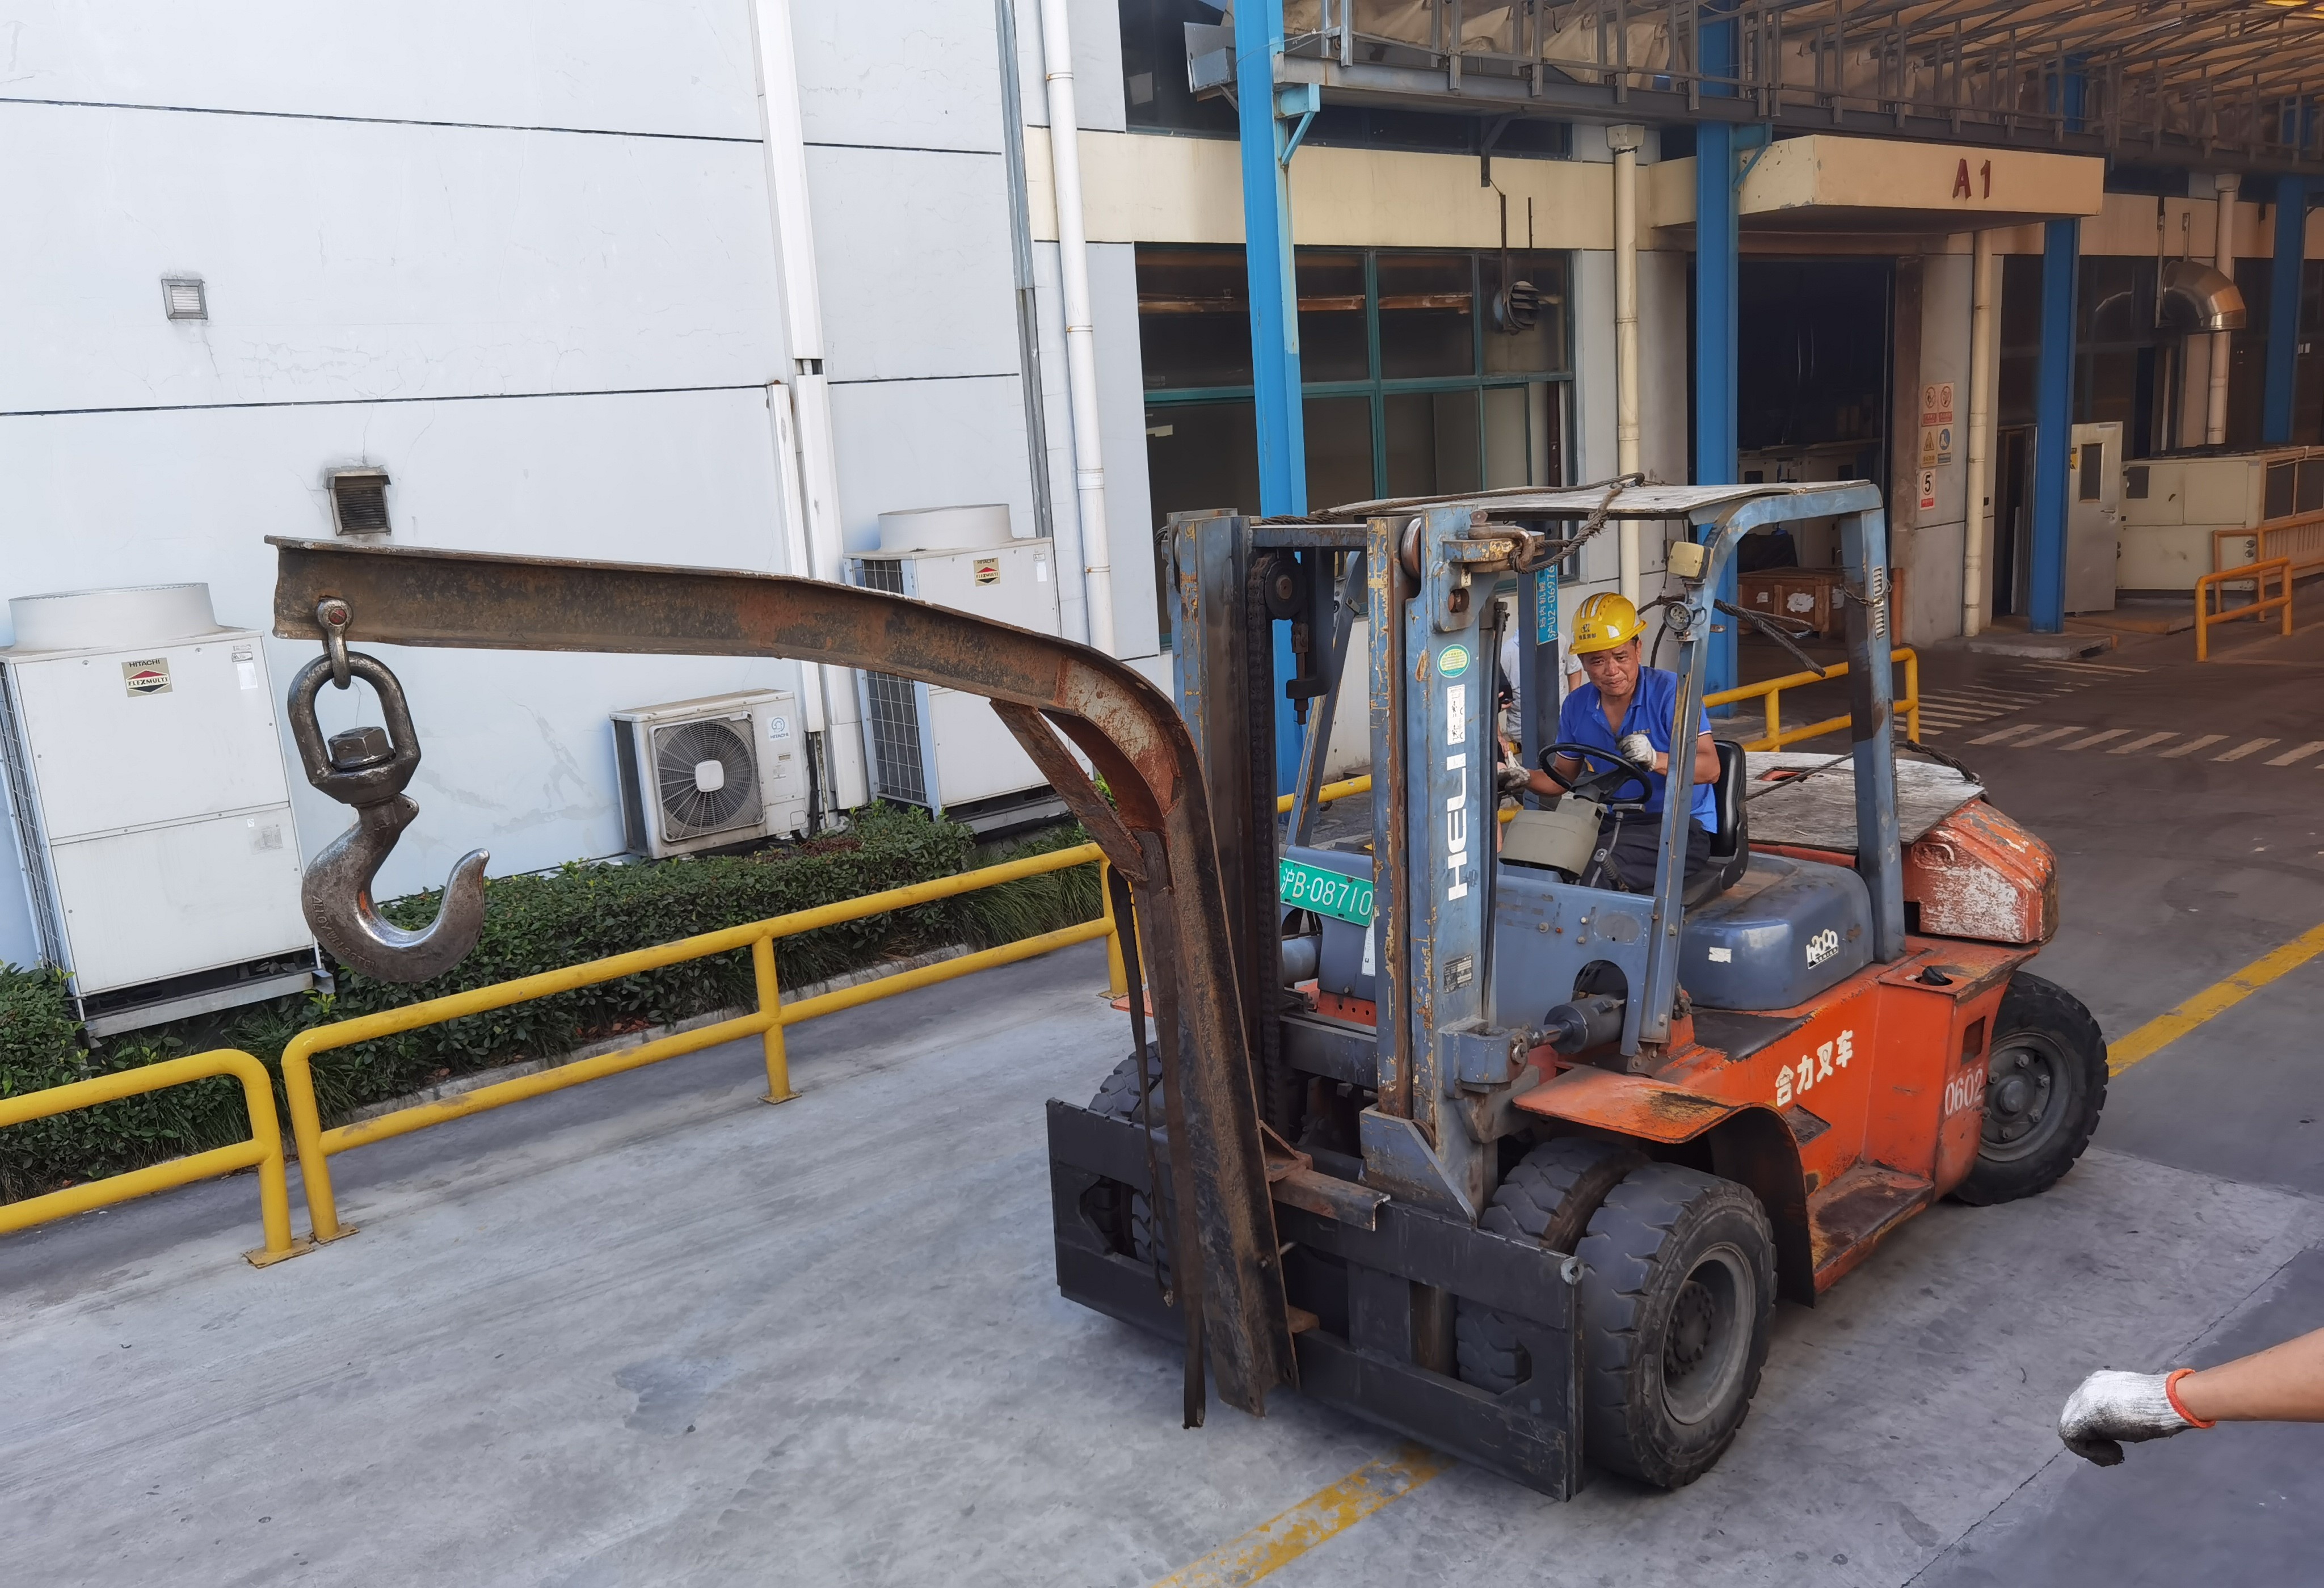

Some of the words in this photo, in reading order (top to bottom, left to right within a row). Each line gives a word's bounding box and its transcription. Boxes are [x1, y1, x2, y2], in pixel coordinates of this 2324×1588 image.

[1925, 475, 1931, 492] 5
[128, 676, 168, 686] FLEXMULTI
[1447, 753, 1467, 901] HELI
[1775, 1030, 1853, 1107] 合力叉车
[1945, 1068, 1982, 1115] 0602
